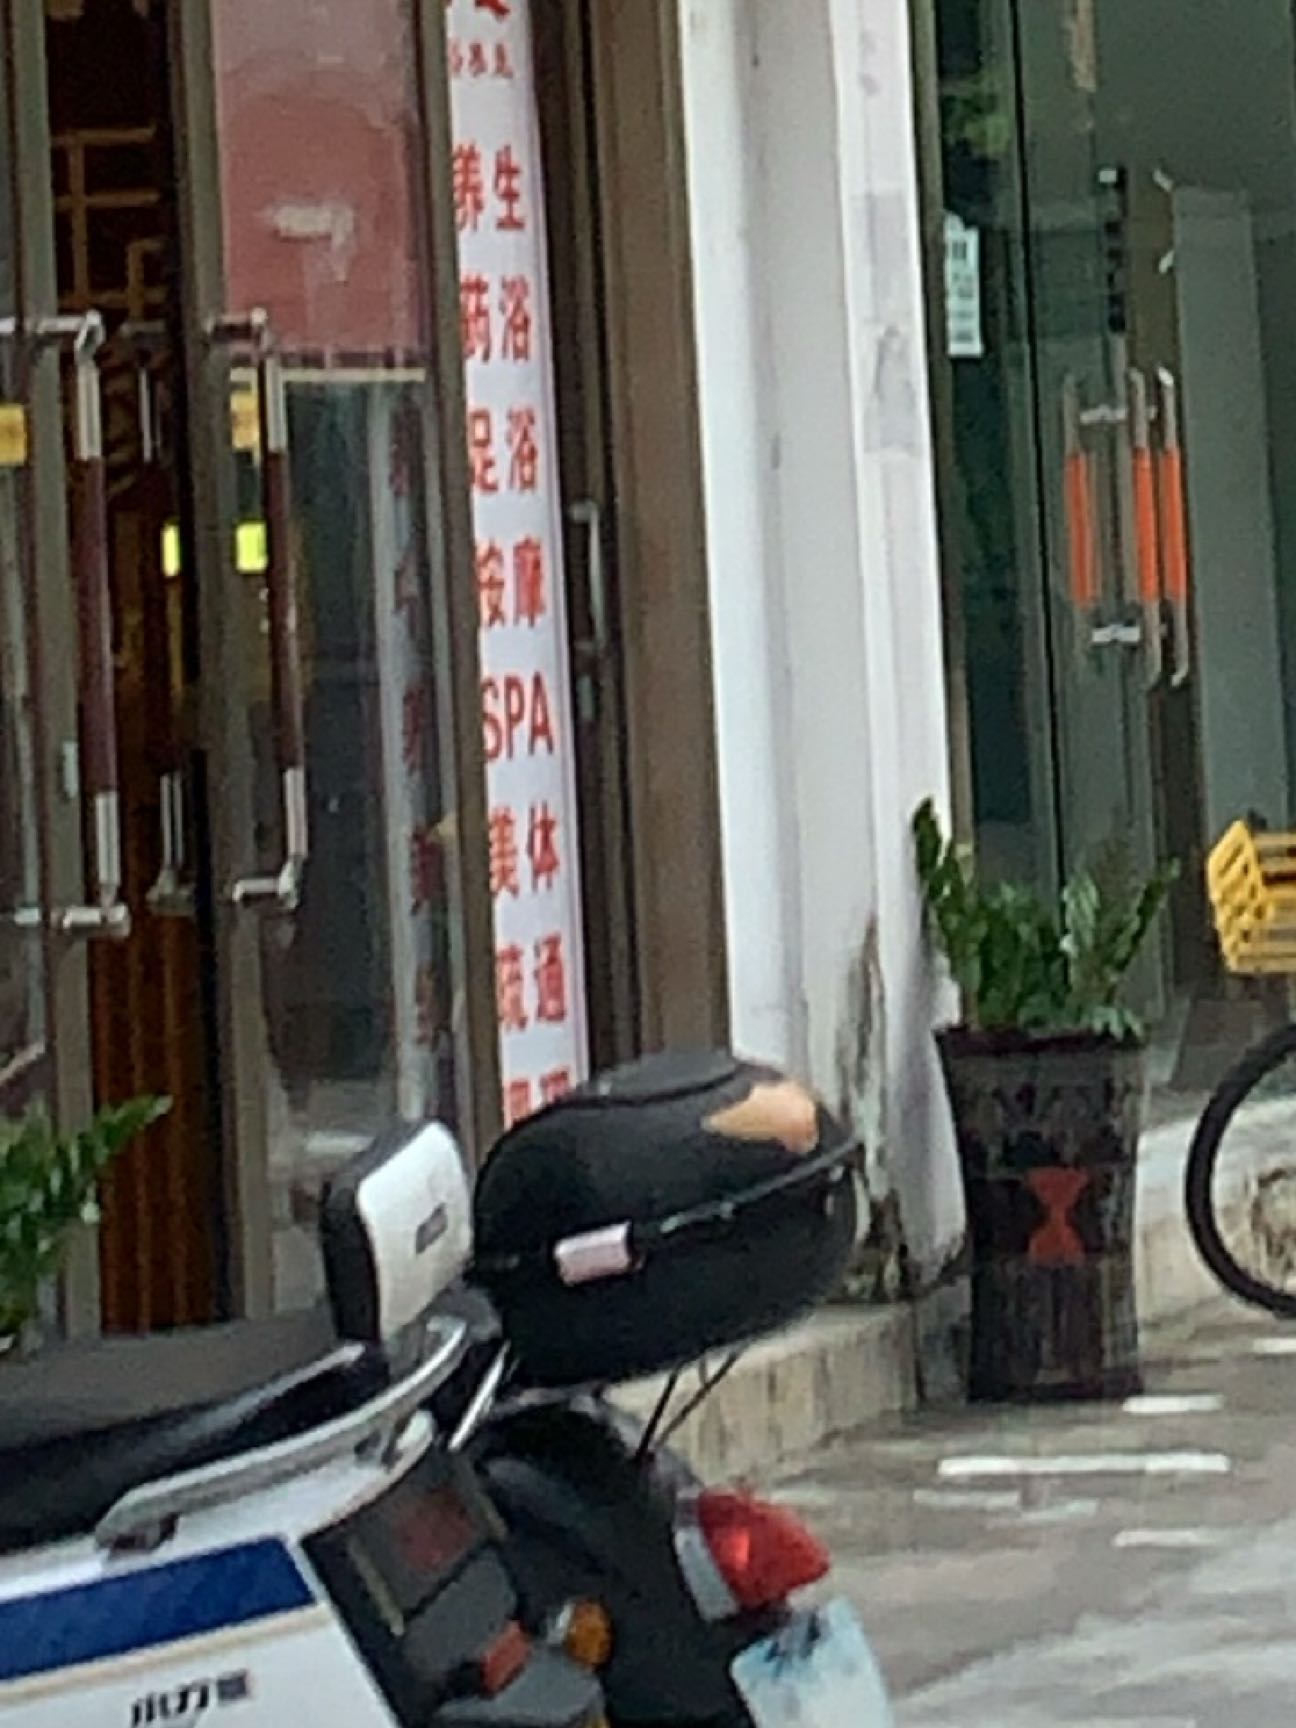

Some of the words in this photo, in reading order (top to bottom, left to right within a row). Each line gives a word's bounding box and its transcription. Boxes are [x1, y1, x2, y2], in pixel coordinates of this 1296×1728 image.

[452, 139, 525, 232] 养生
[481, 669, 554, 760] SPA
[488, 799, 560, 899] 美体
